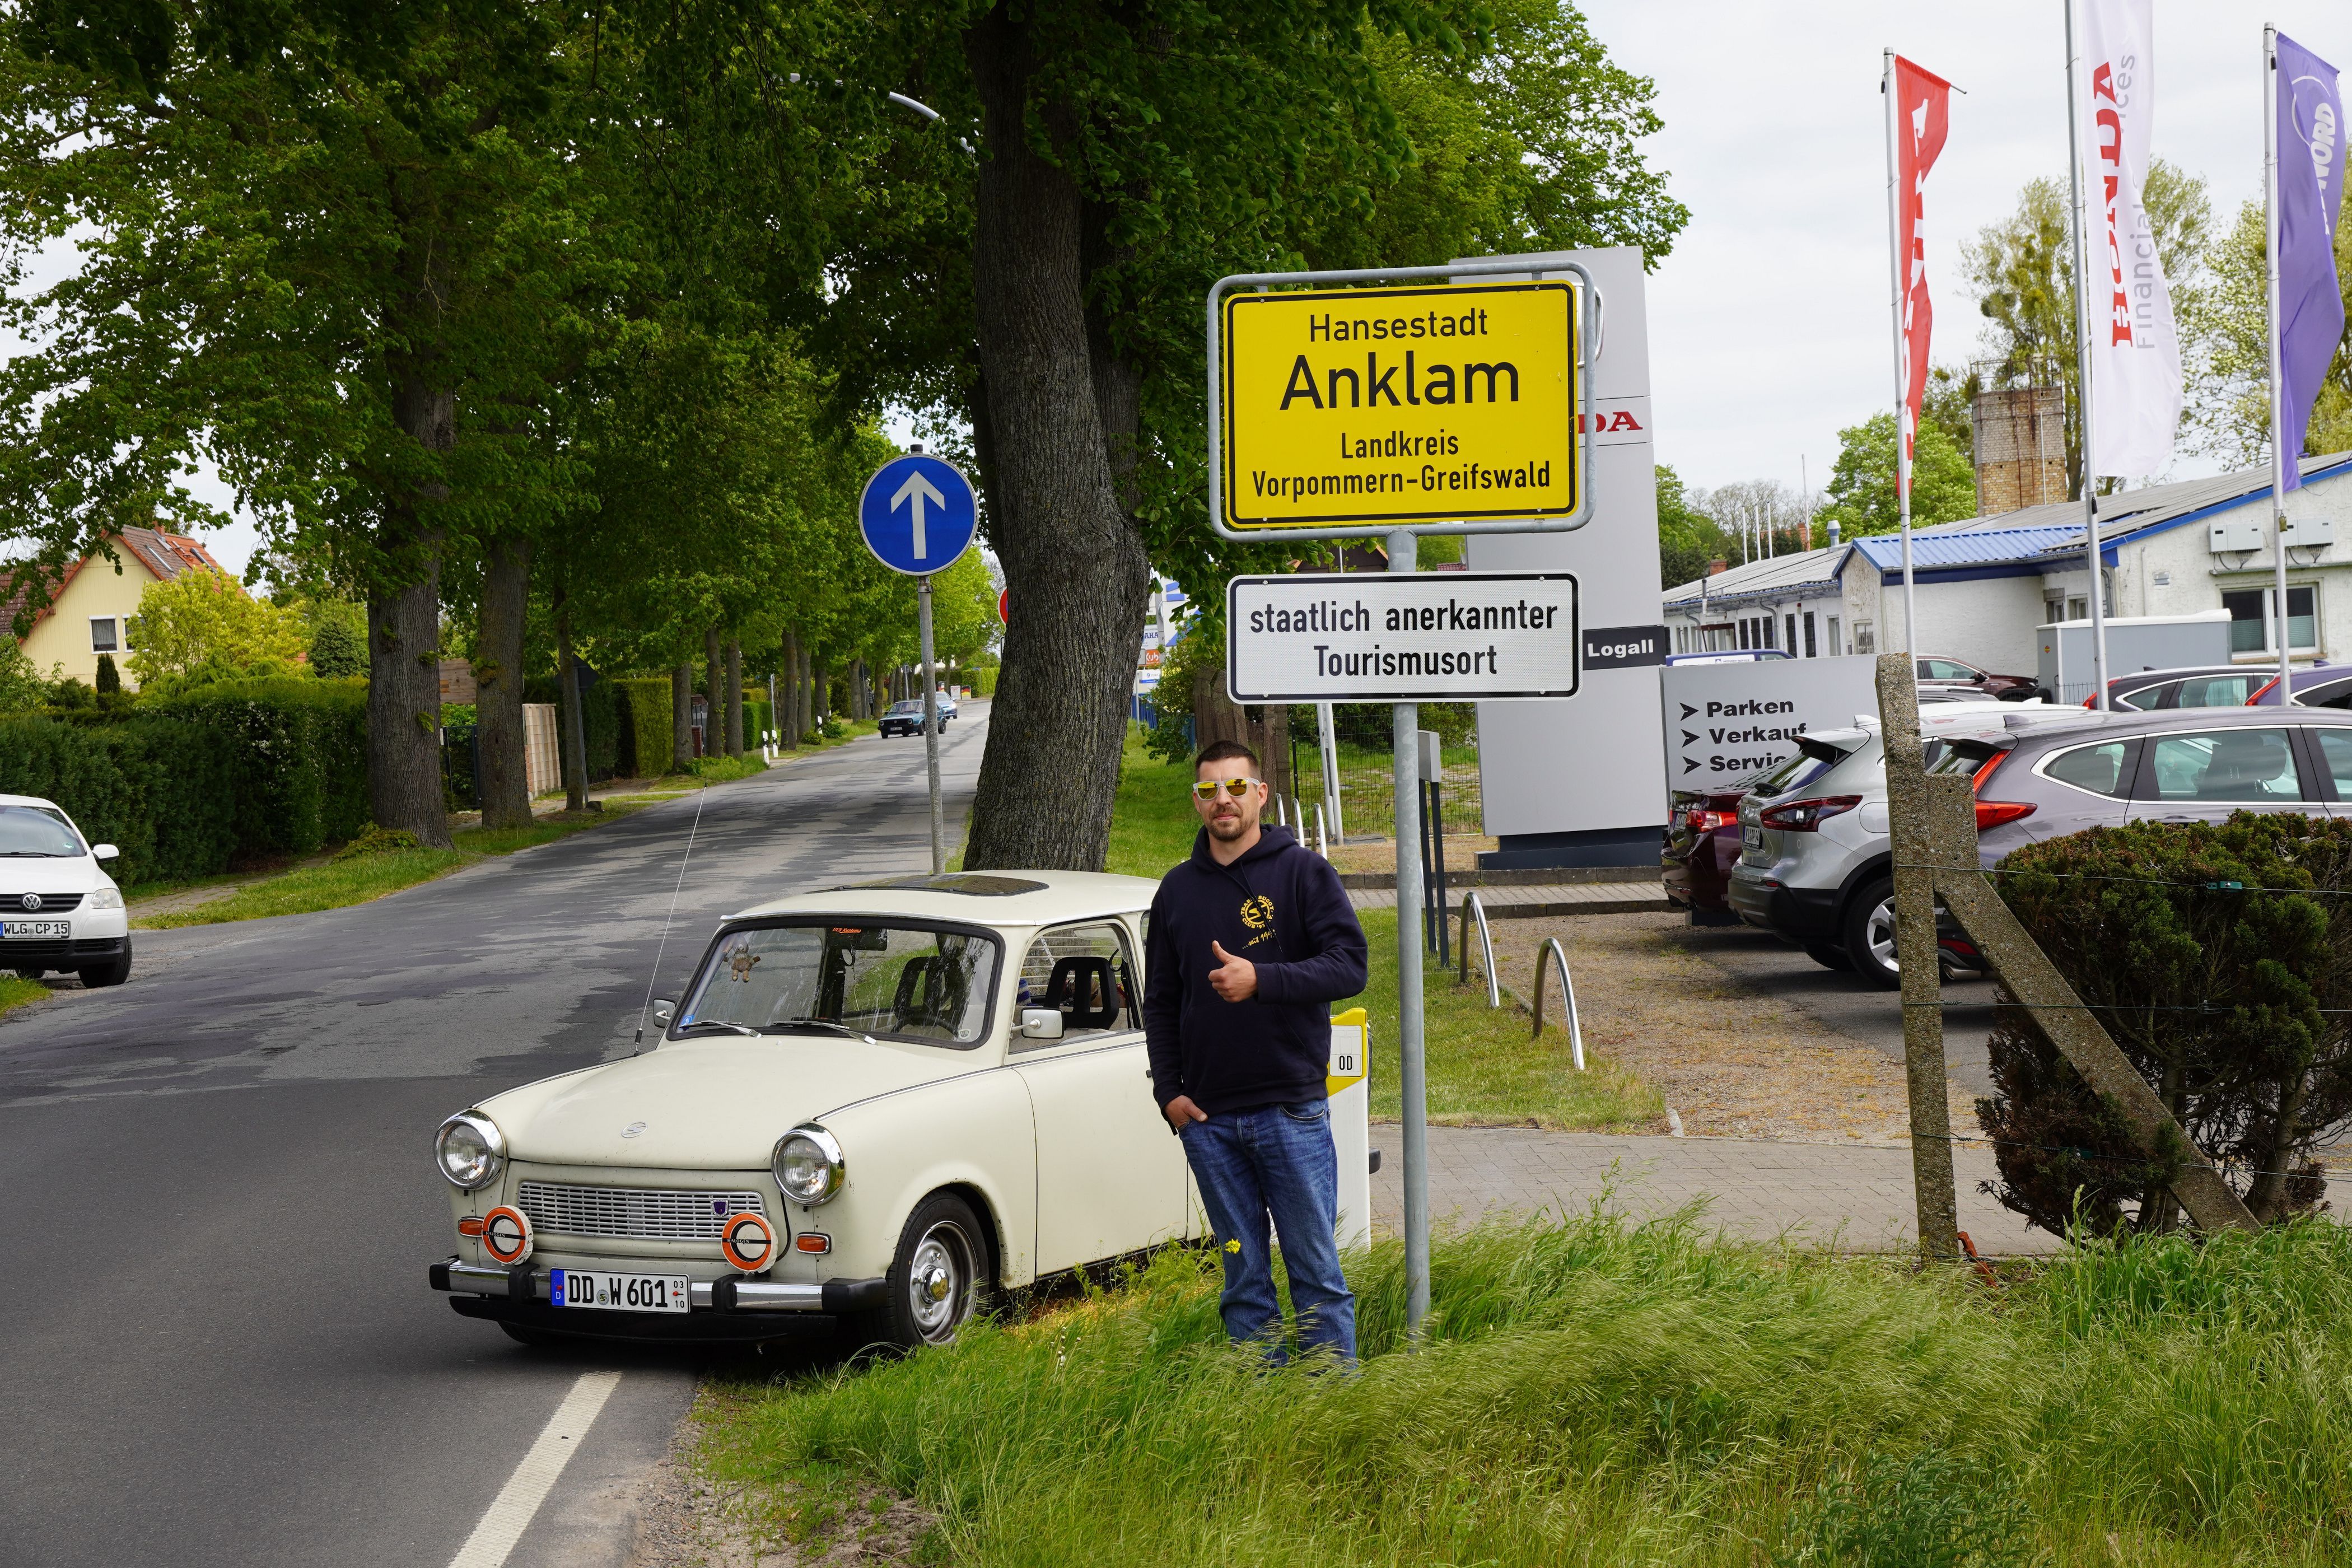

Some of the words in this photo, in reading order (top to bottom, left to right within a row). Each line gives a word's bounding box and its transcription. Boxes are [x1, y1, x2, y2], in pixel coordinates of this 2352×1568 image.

[2093, 62, 2133, 347] HONDA
[1310, 307, 1488, 342] Hansestadt
[1280, 350, 1519, 410] Anklam
[1341, 429, 1459, 459] Landkreis
[1252, 460, 1551, 503] Vorpommern-Greifswald
[1250, 600, 1370, 633] staatlich
[1386, 599, 1558, 631] anerkannter
[1313, 644, 1497, 676] Tourismusort
[1587, 638, 1654, 658] Logall
[1706, 698, 1794, 718] Parken
[1709, 723, 1807, 744] Verkauf
[4, 923, 27, 935] WLG
[35, 923, 51, 935] CP
[54, 923, 68, 935] 15
[1242, 918, 1256, 929] CLUB
[1339, 1055, 1352, 1071] OD
[568, 1275, 594, 1304] DD
[675, 1300, 685, 1308] 10
